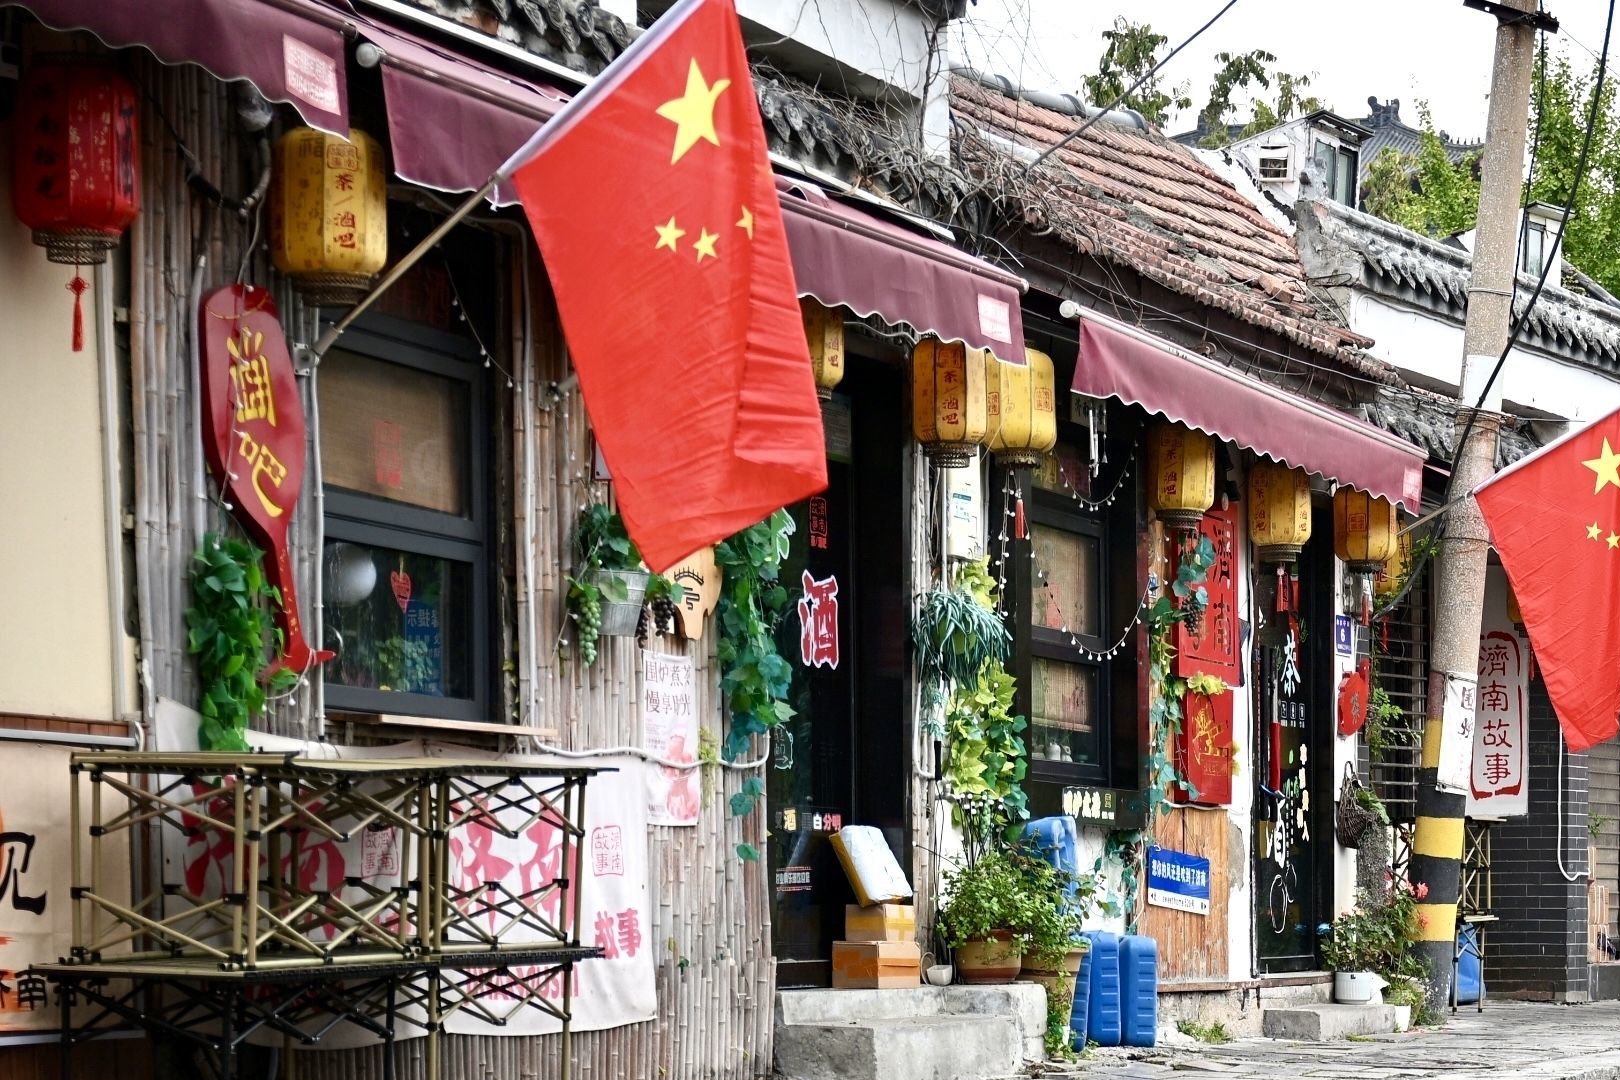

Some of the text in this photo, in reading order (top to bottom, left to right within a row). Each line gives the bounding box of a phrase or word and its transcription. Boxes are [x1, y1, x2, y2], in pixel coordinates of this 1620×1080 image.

[226, 326, 288, 517] 酒吧
[1340, 628, 1346, 642] 6
[645, 660, 691, 686] 围炉煮茶
[645, 689, 691, 716] 慢享时光
[1479, 645, 1512, 785] 濟南故事
[594, 908, 641, 959] 故事
